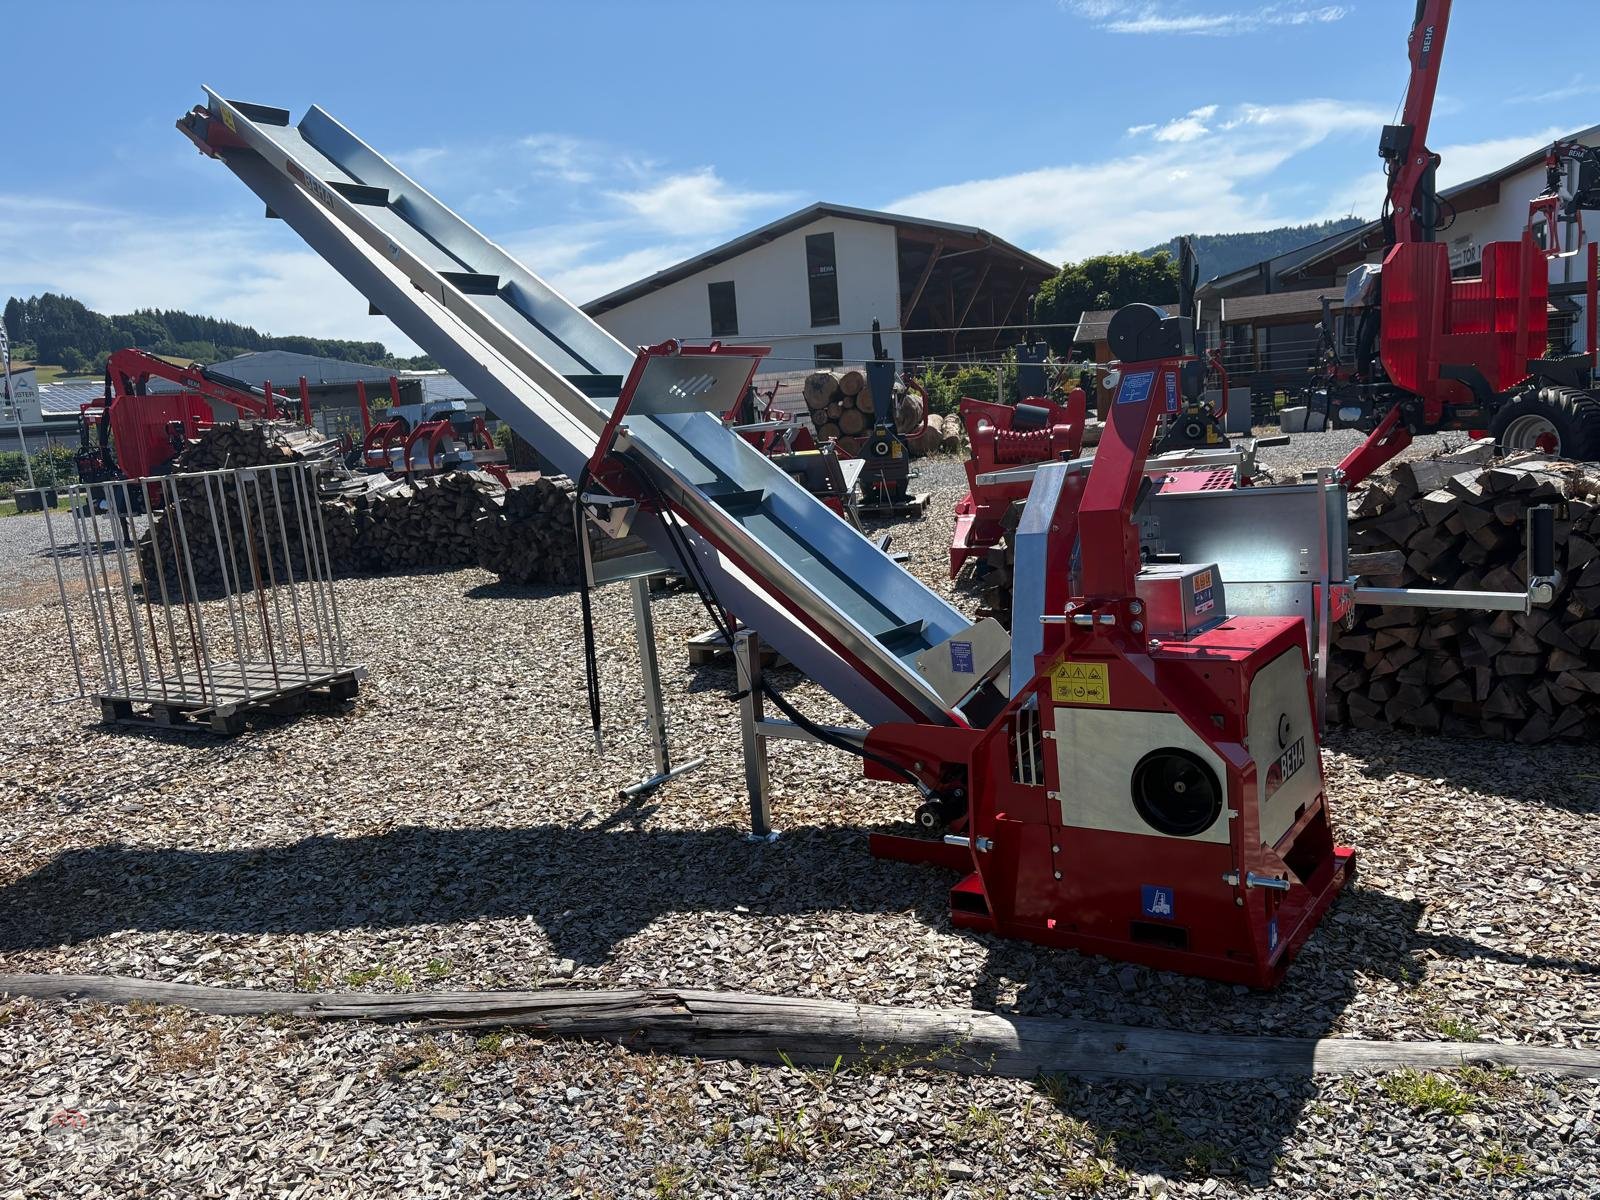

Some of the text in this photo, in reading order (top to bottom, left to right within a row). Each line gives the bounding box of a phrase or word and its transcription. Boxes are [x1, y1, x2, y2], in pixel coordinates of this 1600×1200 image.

[1423, 25, 1434, 52] BEHA
[1568, 149, 1584, 158] BEHA
[304, 174, 332, 206] BEHA
[1463, 247, 1476, 264] TOR
[1281, 738, 1305, 782] BEHA
